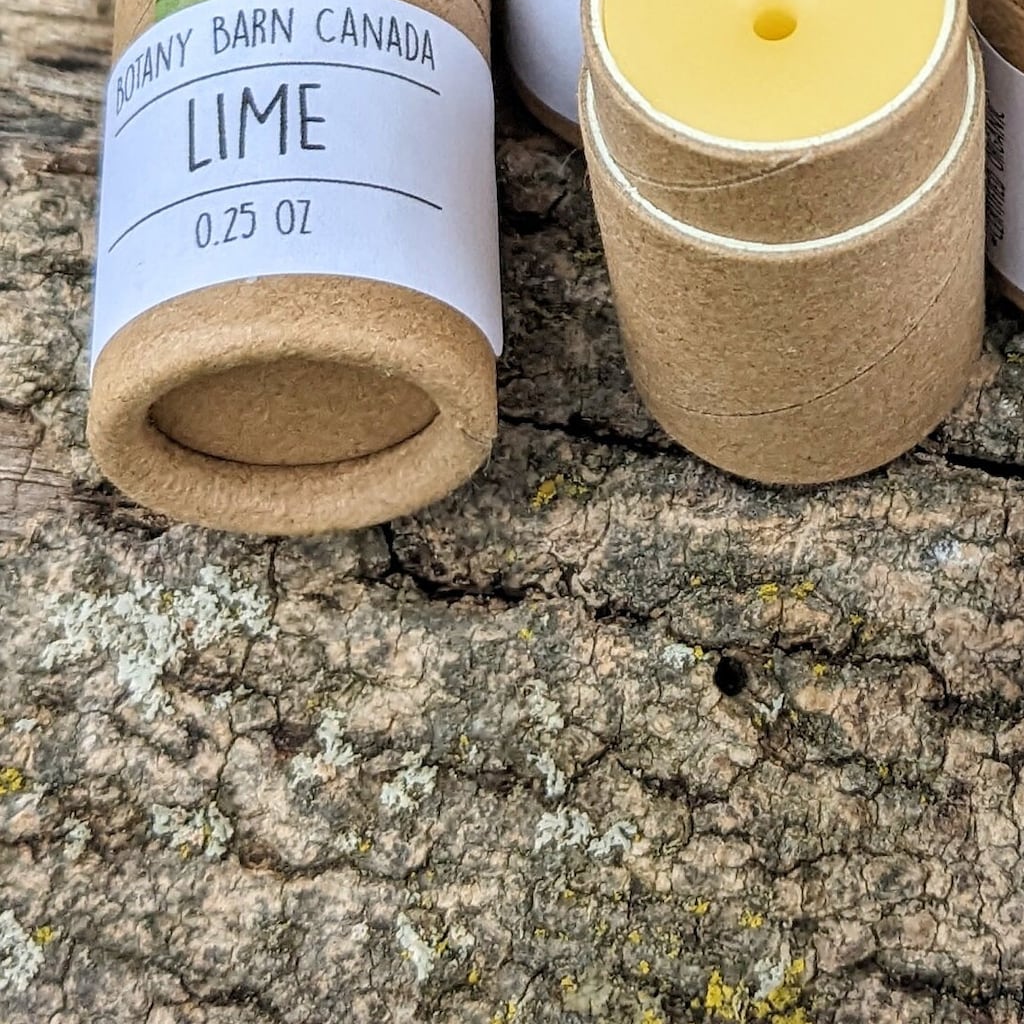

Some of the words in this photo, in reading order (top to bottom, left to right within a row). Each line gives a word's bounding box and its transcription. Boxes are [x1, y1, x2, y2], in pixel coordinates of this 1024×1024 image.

[115, 27, 193, 115] BOTANY
[212, 7, 294, 54] BARN
[316, 7, 435, 70] CANADA
[188, 83, 326, 172] LIME
[195, 202, 256, 248] 0.25
[276, 199, 311, 235] OZ
